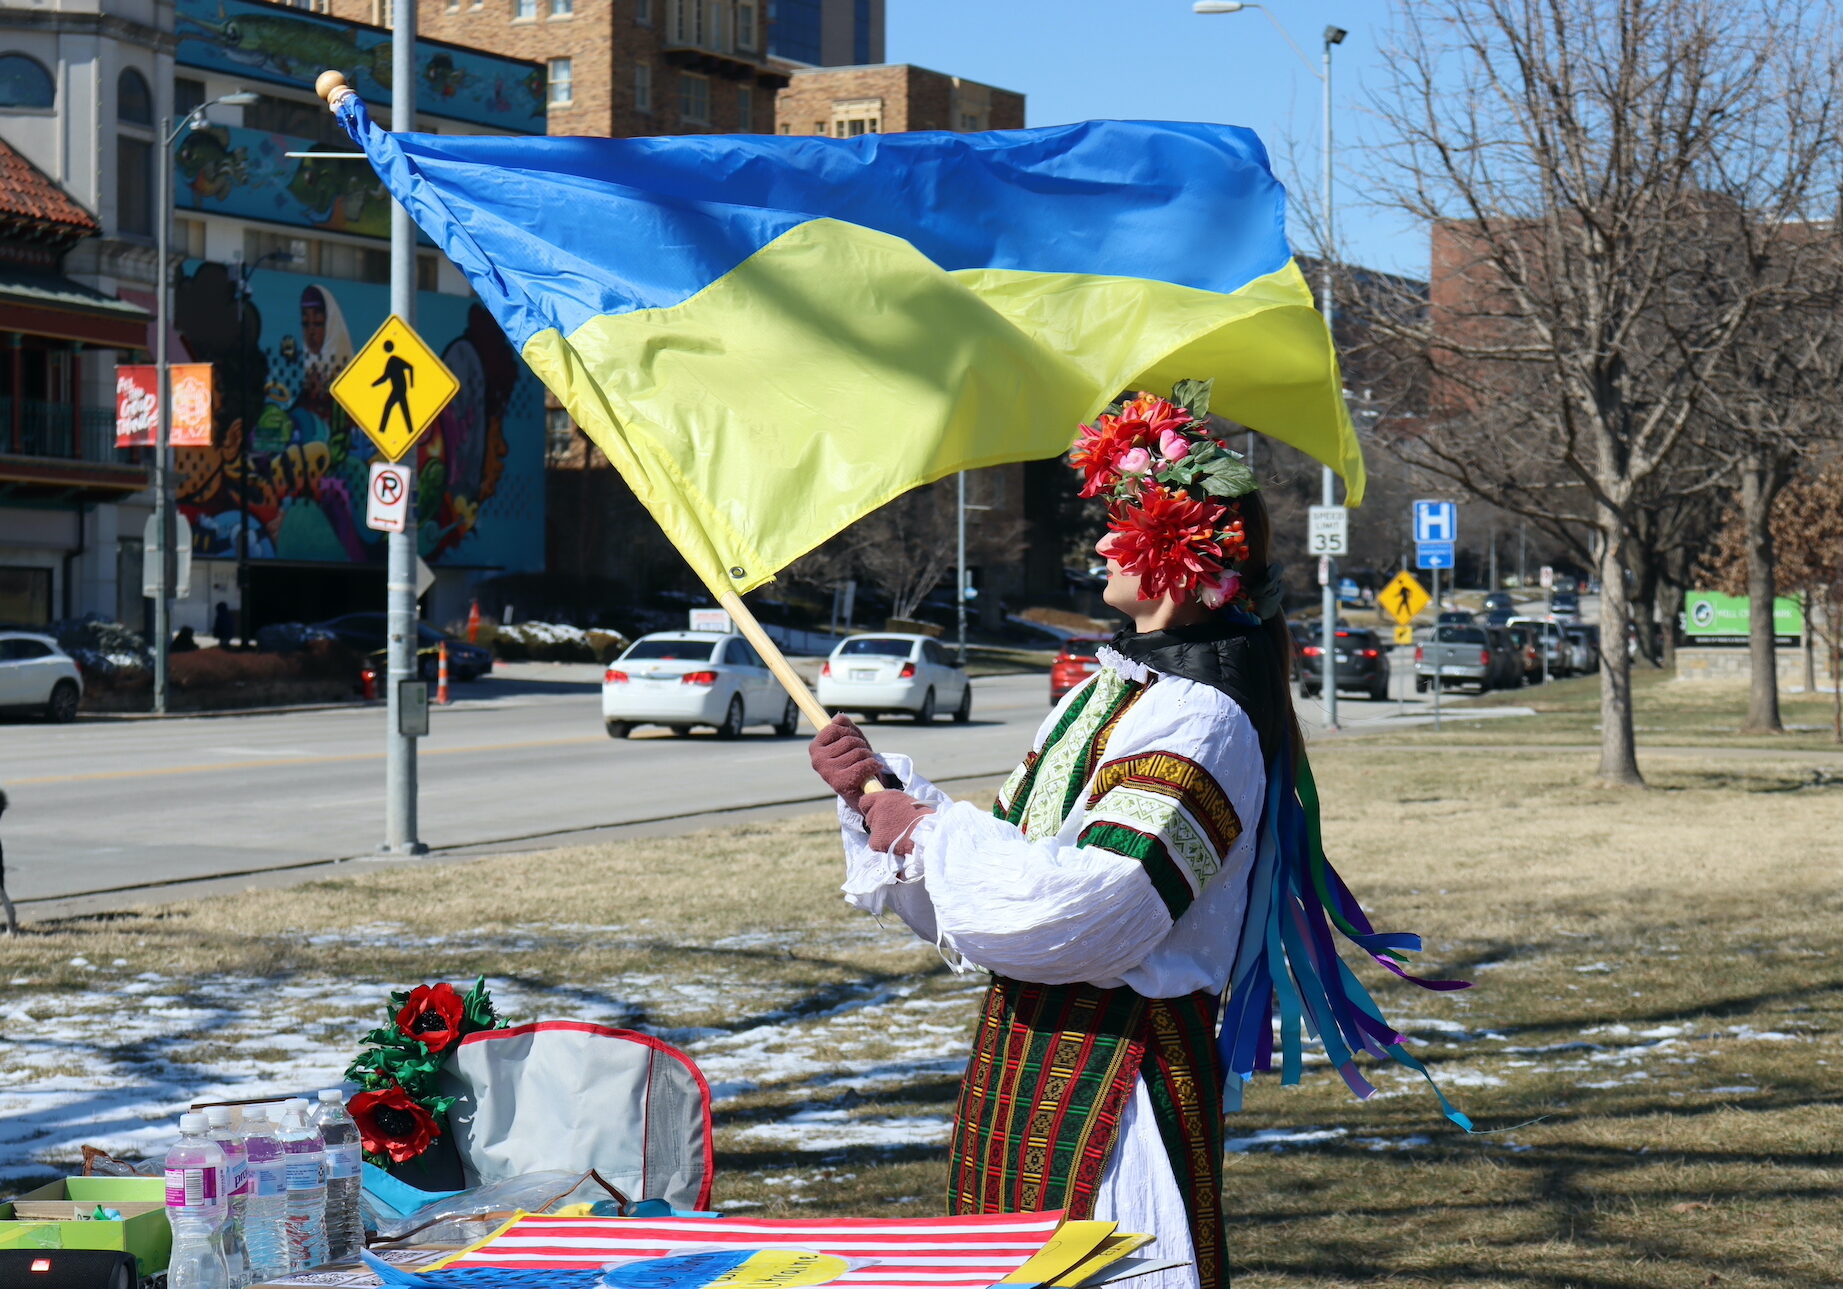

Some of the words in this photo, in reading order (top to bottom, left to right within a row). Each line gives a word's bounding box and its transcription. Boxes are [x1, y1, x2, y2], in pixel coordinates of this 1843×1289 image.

[1419, 503, 1450, 540] H
[1314, 533, 1342, 551] 35
[742, 1254, 819, 1288] Ukraine
